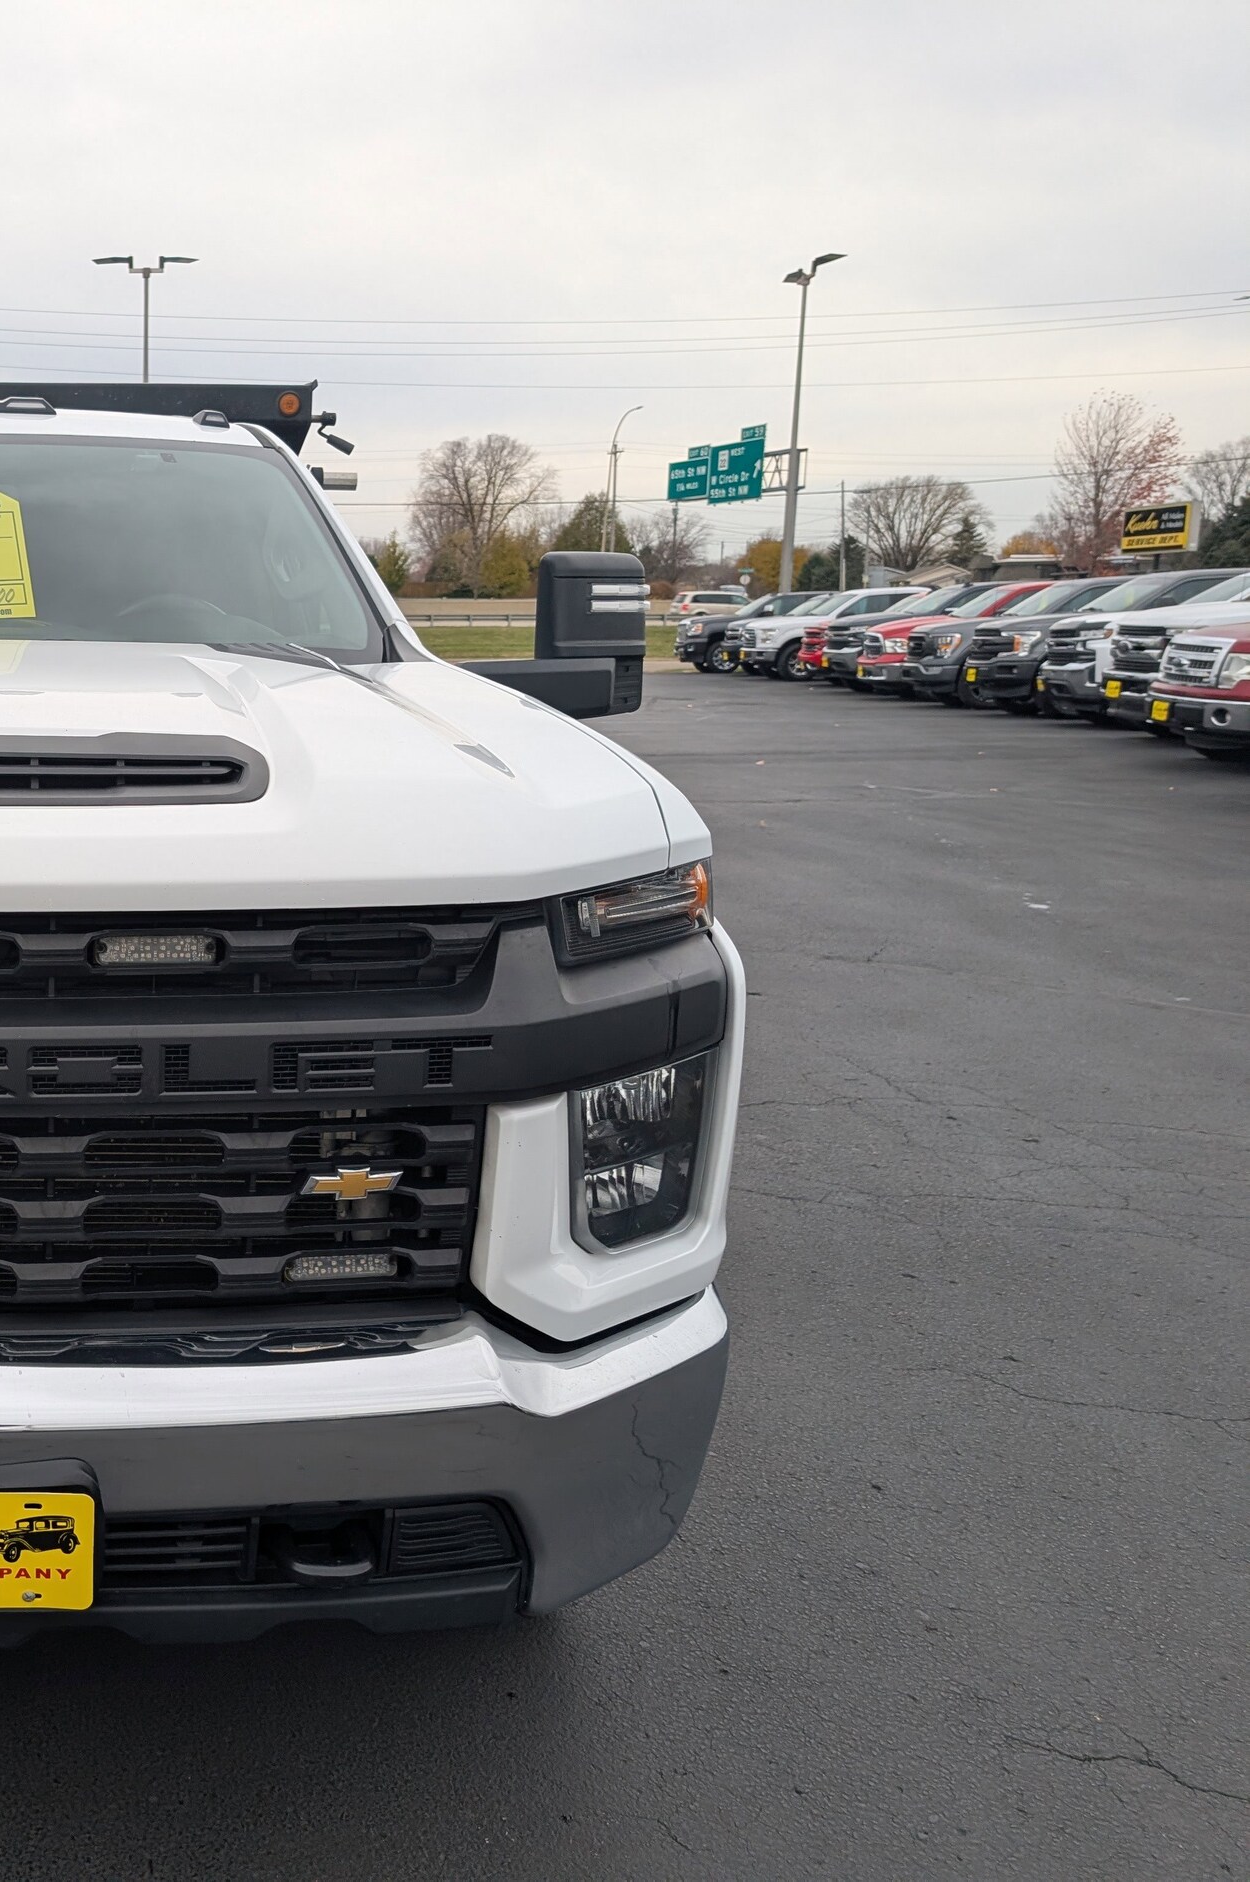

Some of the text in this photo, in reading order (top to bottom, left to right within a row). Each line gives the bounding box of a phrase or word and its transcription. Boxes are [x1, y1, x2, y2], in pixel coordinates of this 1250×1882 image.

[730, 447, 745, 456] WEST
[719, 457, 727, 469] 22
[670, 465, 706, 480] 65th St NW
[718, 474, 739, 484] Circle
[740, 471, 749, 481] Dr
[710, 485, 749, 498] 55th St NW
[1125, 512, 1159, 533] Kuehn
[1126, 537, 1157, 547] SERVICE
